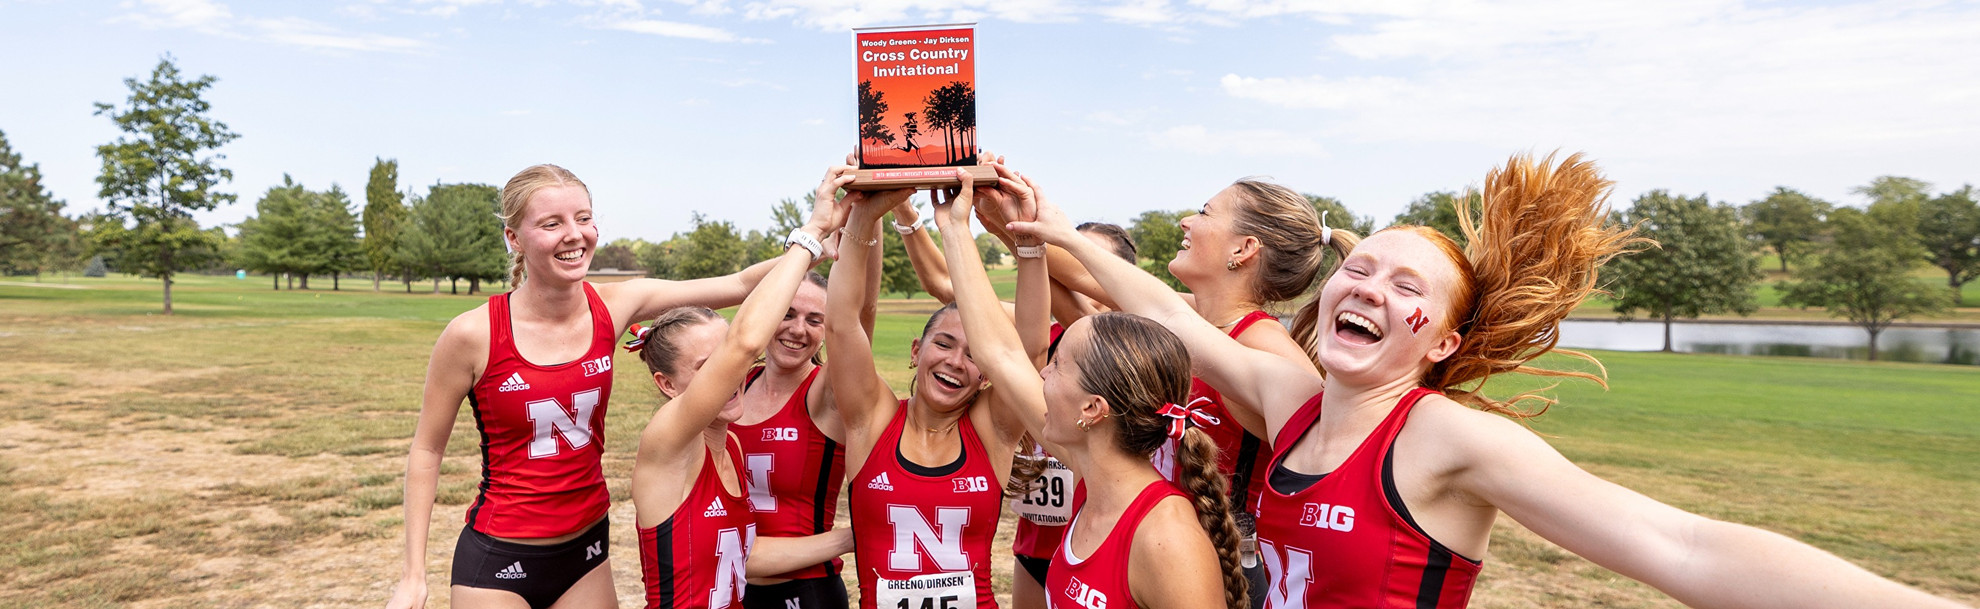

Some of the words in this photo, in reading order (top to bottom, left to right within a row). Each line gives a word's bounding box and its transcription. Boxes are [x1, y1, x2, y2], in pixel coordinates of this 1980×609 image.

[862, 50, 905, 62] Cross
[909, 47, 969, 60] Country
[873, 62, 959, 77] Invitational
[1403, 305, 1431, 338] N
[499, 383, 531, 392] adidas
[525, 387, 602, 460] N
[867, 482, 894, 491] adidas
[1022, 475, 1065, 508] 139
[703, 508, 728, 518] adidas
[886, 503, 972, 573] N
[586, 540, 603, 561] N
[888, 576, 964, 590] GREENO/DIRKSEN
